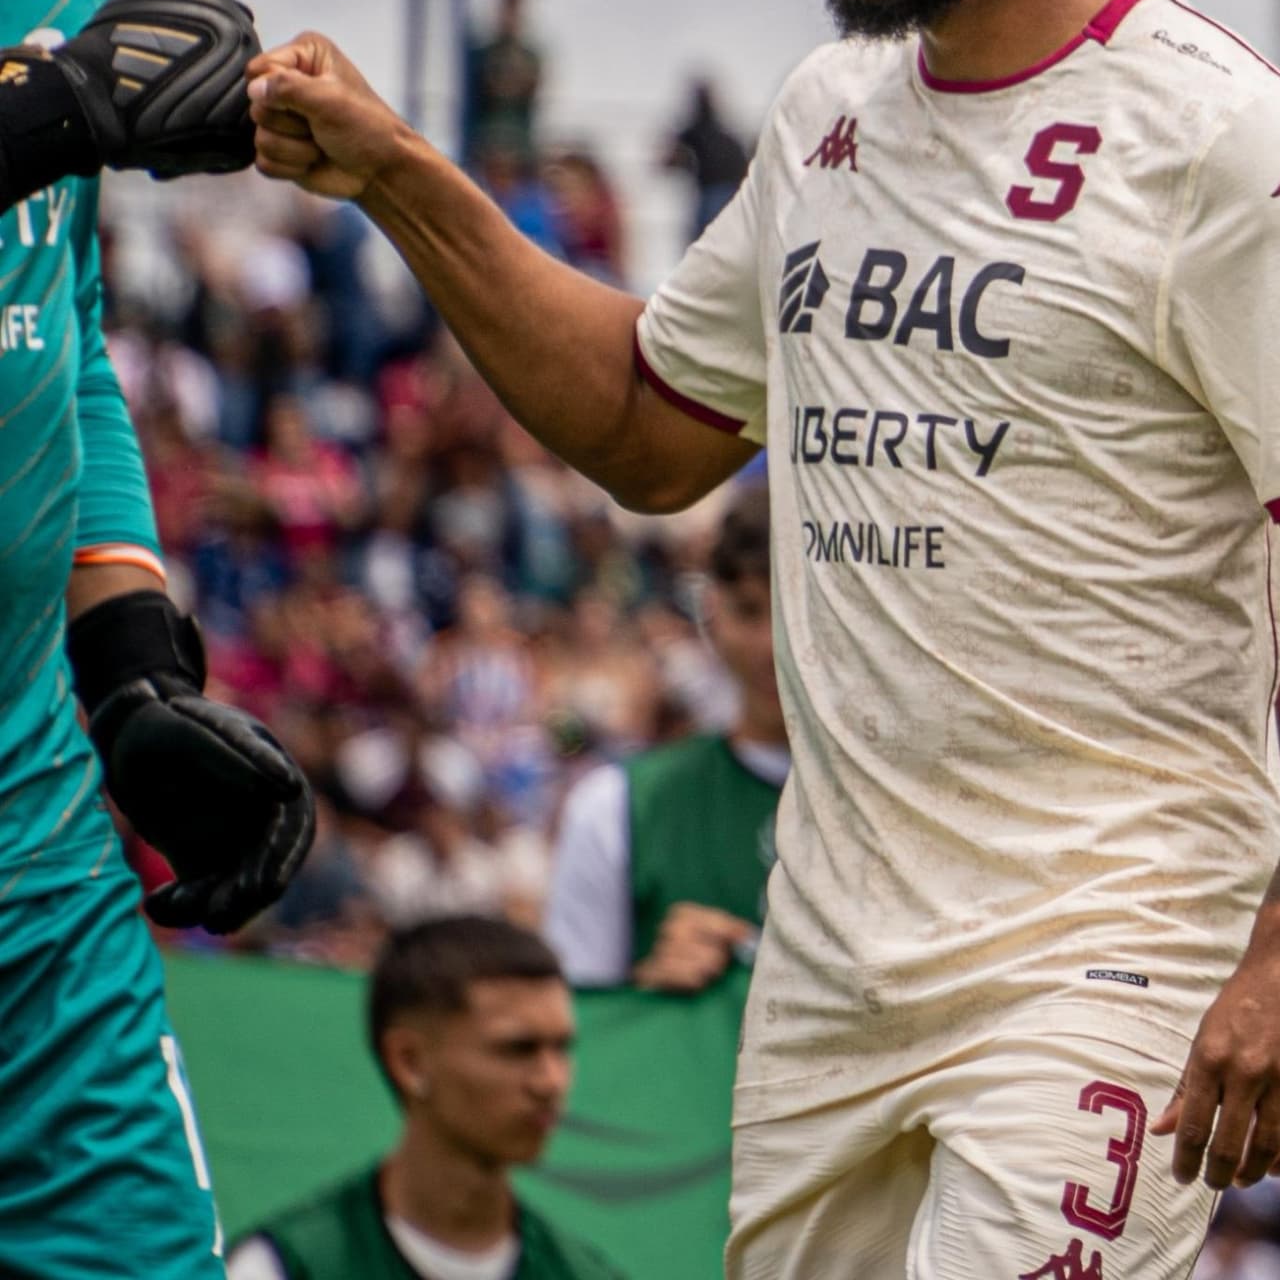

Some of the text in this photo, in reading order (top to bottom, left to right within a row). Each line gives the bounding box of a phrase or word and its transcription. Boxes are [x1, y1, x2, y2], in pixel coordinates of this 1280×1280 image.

[1006, 122, 1102, 222] S
[844, 247, 1026, 359] BAC
[1089, 971, 1146, 986] KOMBAT
[1061, 1079, 1148, 1242] 3
